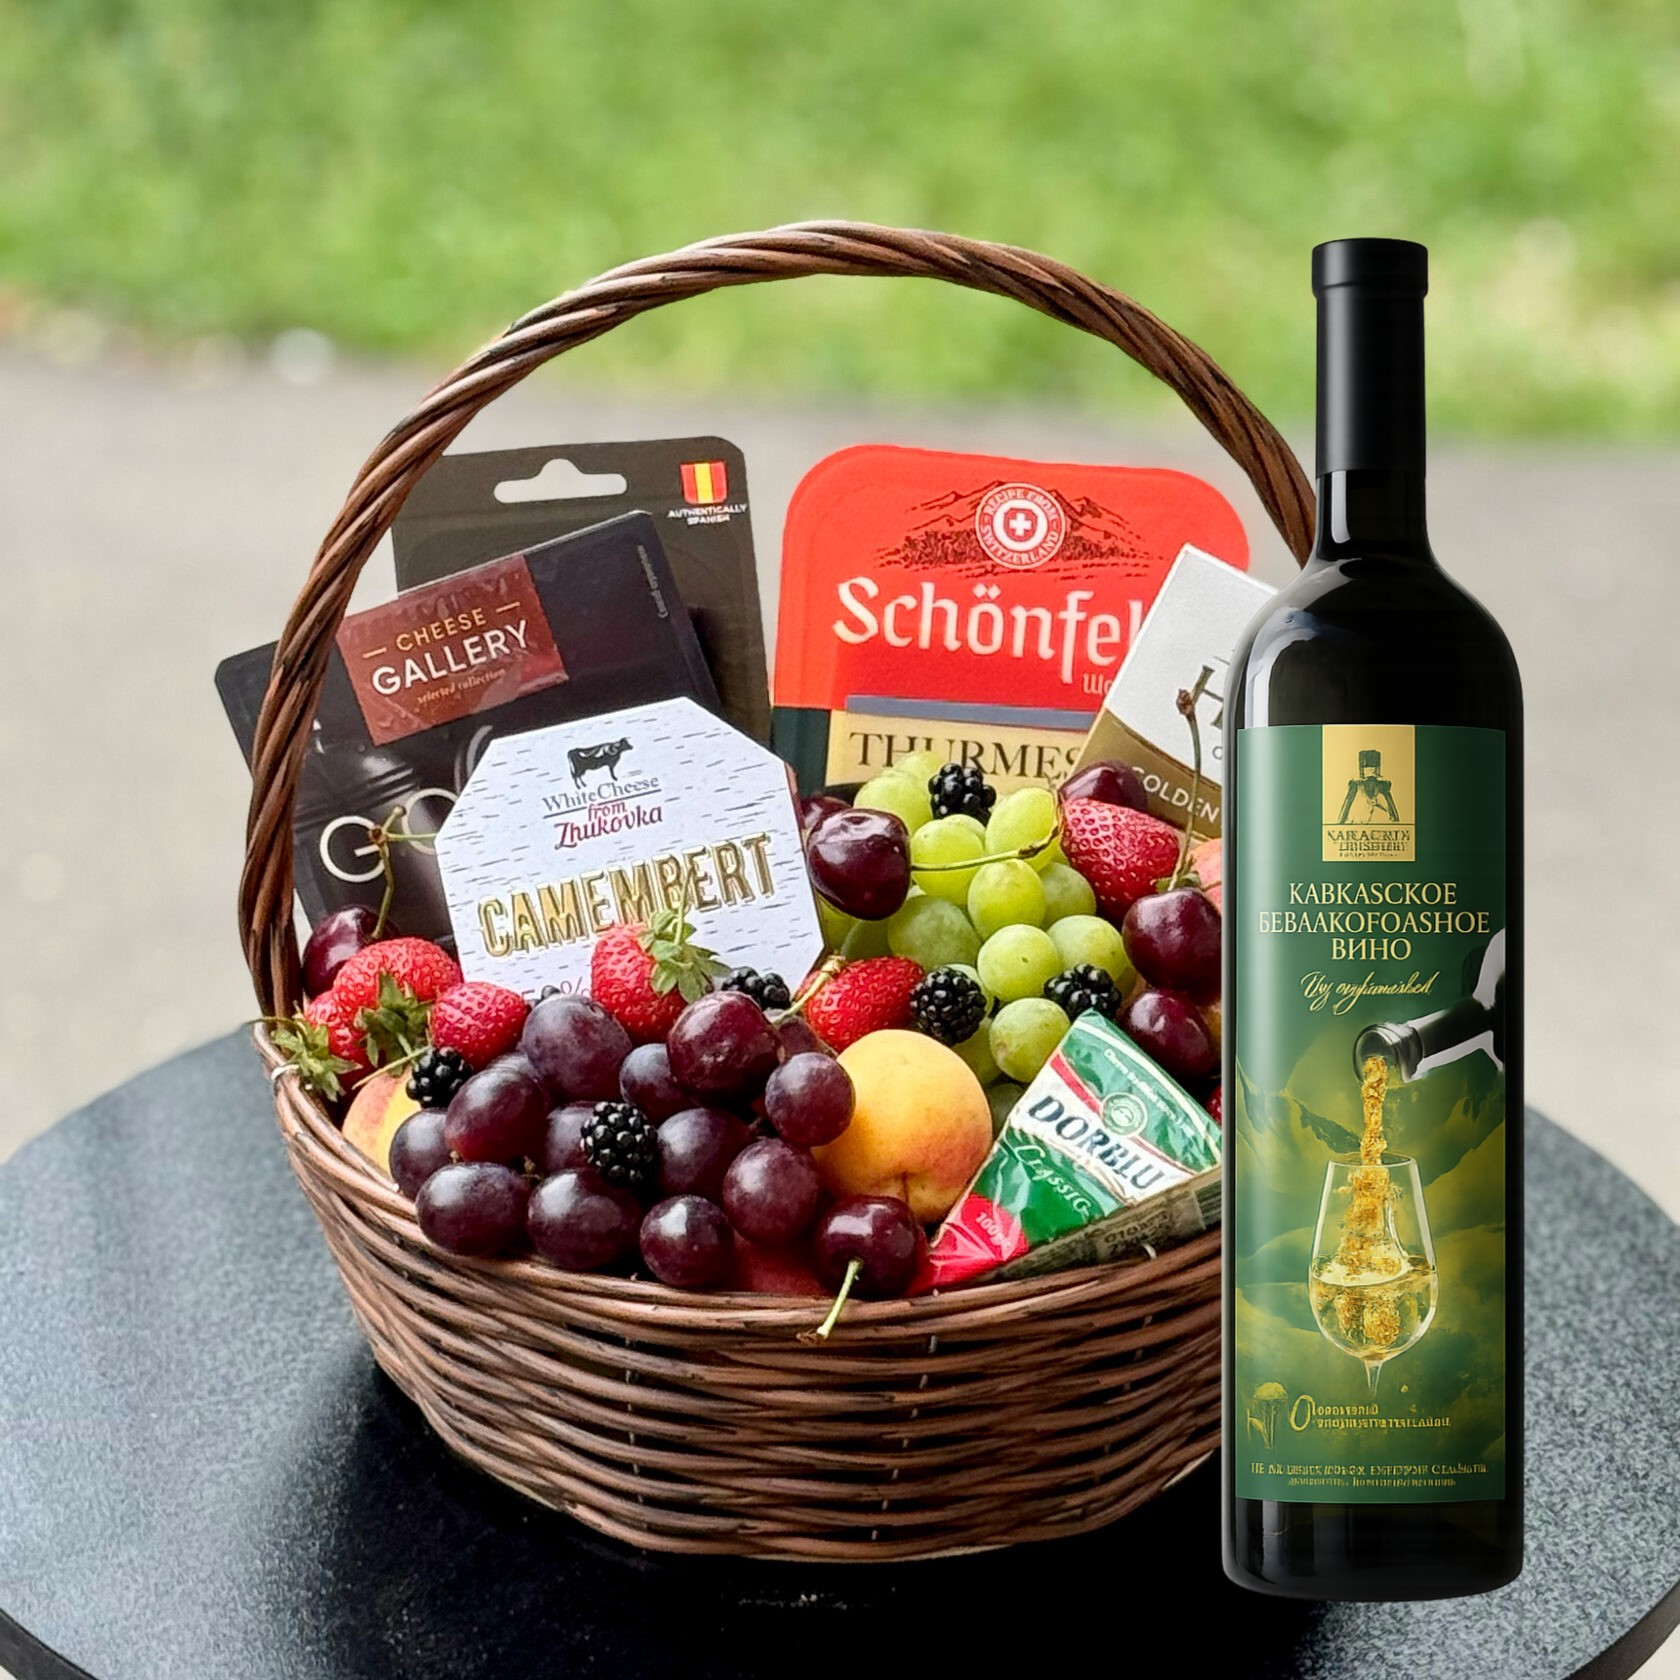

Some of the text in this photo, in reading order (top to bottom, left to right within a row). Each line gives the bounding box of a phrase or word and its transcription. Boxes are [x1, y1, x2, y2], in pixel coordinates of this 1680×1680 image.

[667, 503, 747, 519] AUTHENTICALLY
[980, 524, 1060, 565] SWITZERLAND
[396, 607, 487, 652] CHEESE
[371, 619, 528, 695] GALLERY
[417, 669, 507, 704] selected collection
[588, 801, 627, 821] from
[1132, 766, 1220, 824] OLDEN
[553, 805, 663, 851] Zhukovka
[478, 831, 775, 958] CAMEMBERT
[1331, 938, 1412, 960] ВИНО
[1028, 1095, 1164, 1191] DORBLU
